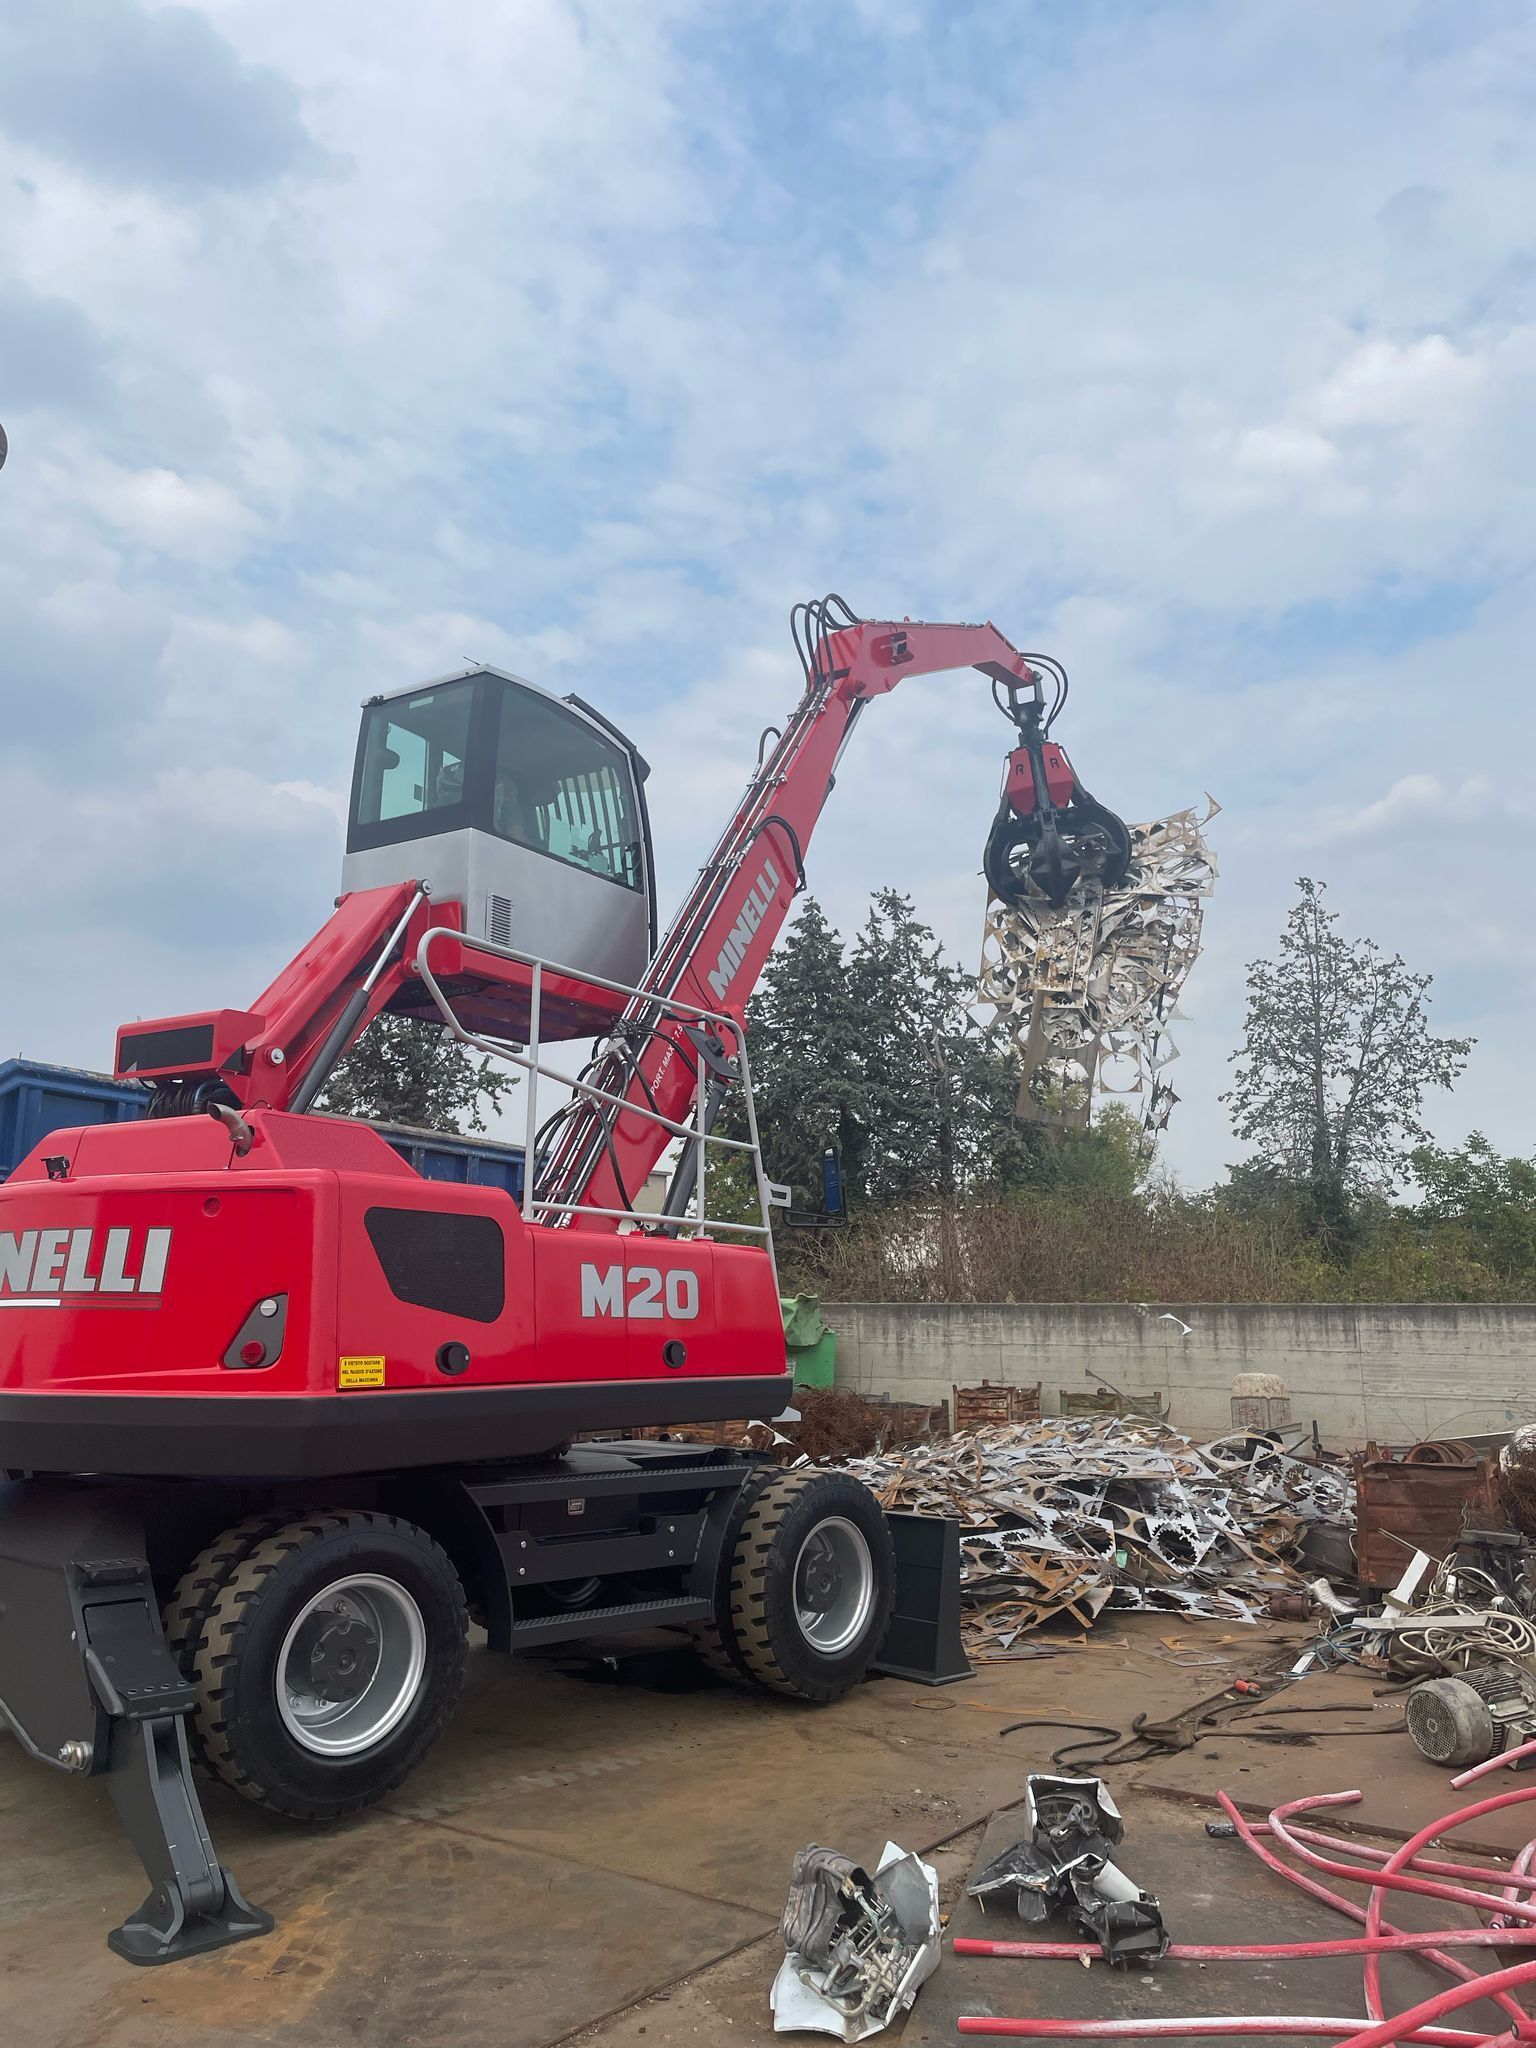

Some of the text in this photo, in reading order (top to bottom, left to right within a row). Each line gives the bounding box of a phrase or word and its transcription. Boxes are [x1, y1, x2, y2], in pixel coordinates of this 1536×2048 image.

[707, 857, 781, 1002] MINELLI
[650, 1066, 666, 1096] PORT.
[662, 1044, 675, 1067] MAX
[580, 1262, 699, 1320] M20
